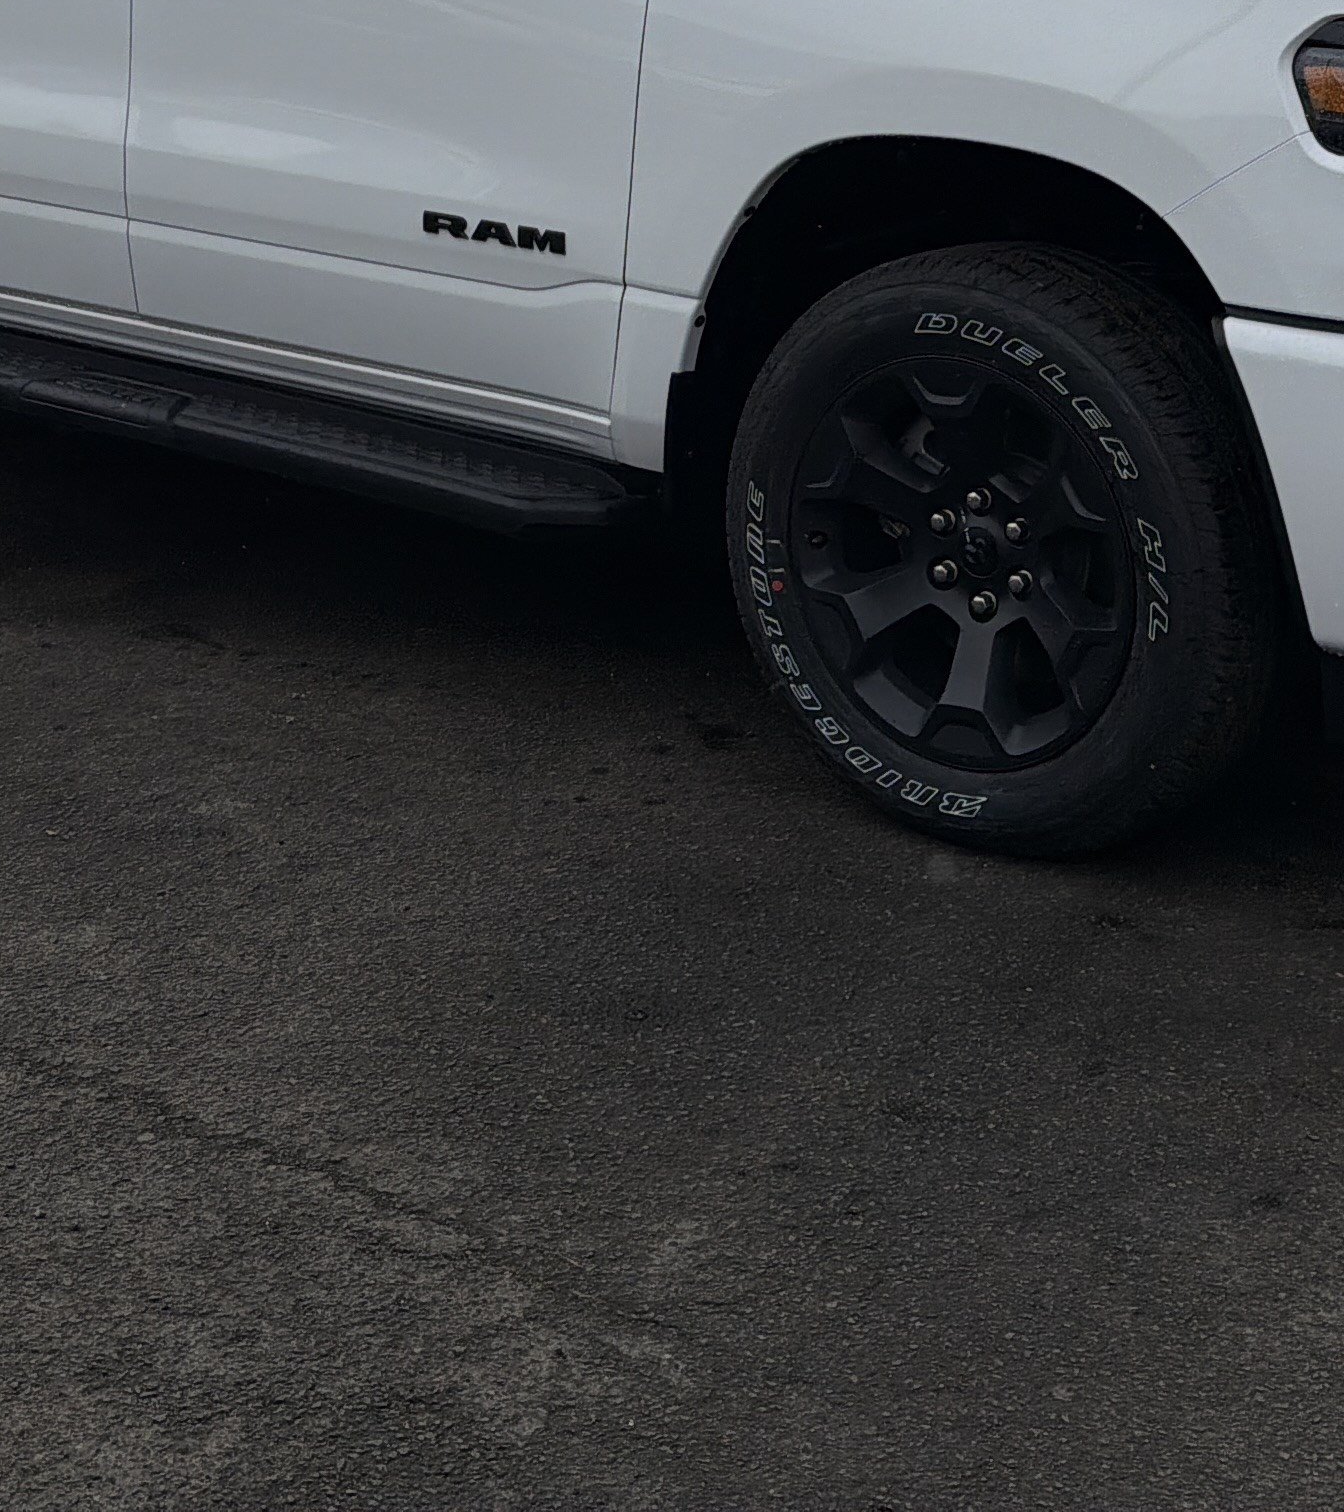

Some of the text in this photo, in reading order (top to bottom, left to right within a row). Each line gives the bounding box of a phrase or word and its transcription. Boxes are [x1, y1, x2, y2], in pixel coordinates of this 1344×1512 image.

[422, 209, 567, 256] RAM
[913, 311, 1172, 643] DUELER H/L
[745, 479, 989, 819] BRIDGESTONE
